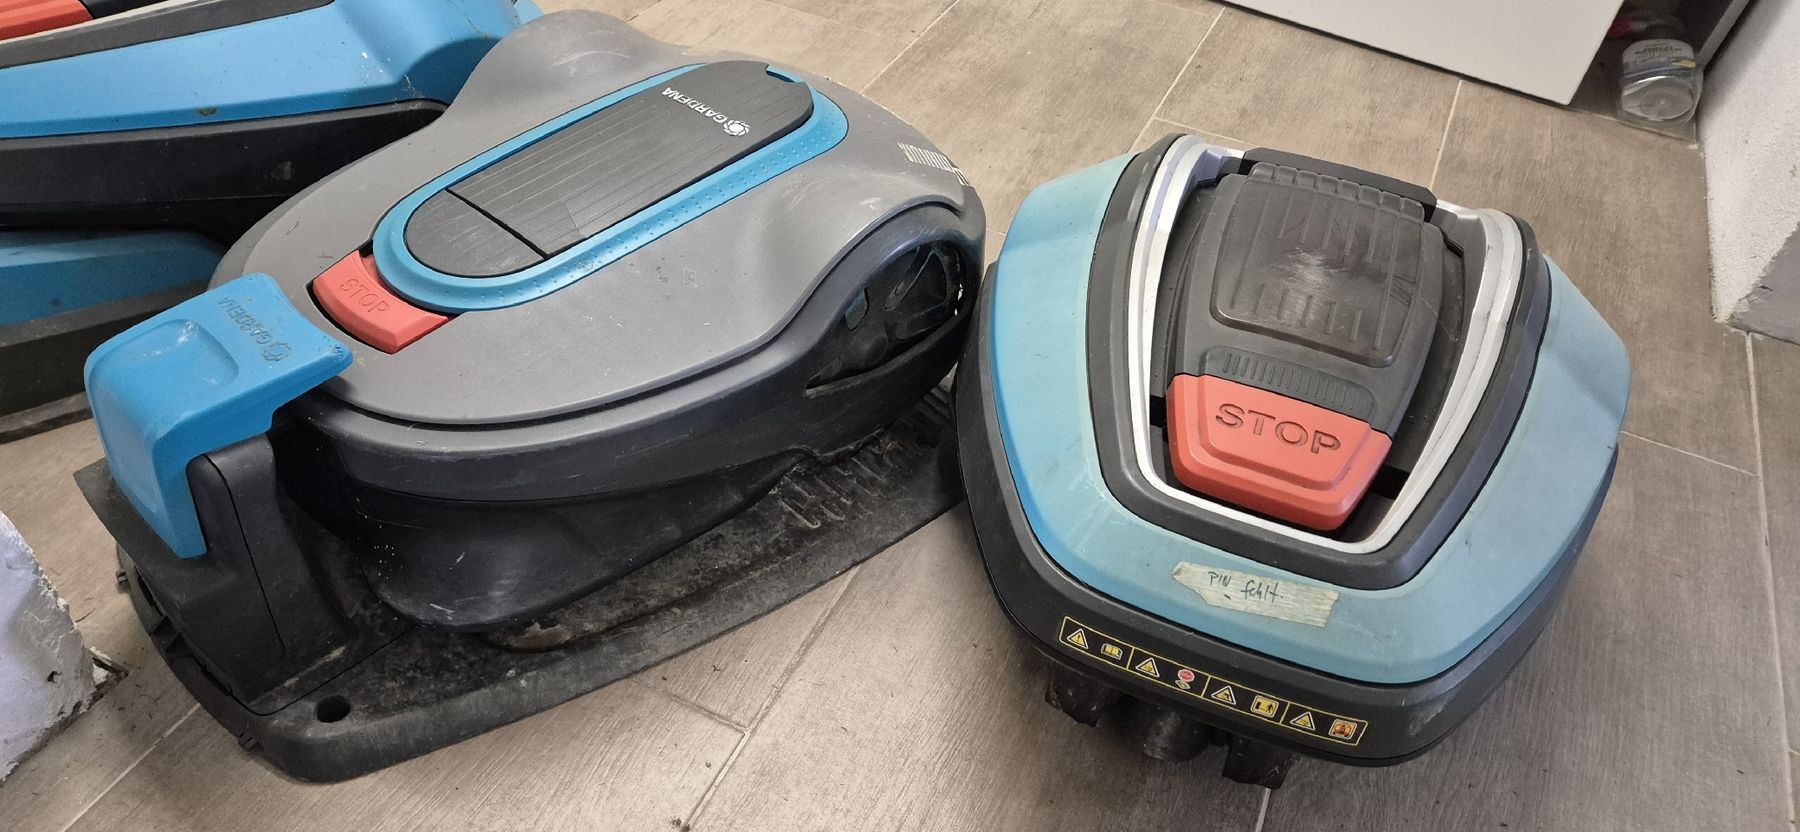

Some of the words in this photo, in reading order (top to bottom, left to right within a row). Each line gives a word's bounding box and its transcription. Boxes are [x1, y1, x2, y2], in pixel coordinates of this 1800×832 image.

[661, 86, 729, 124] GARDENA
[339, 278, 390, 313] STOP
[1215, 402, 1341, 454] STOP
[1207, 571, 1232, 587] PIN
